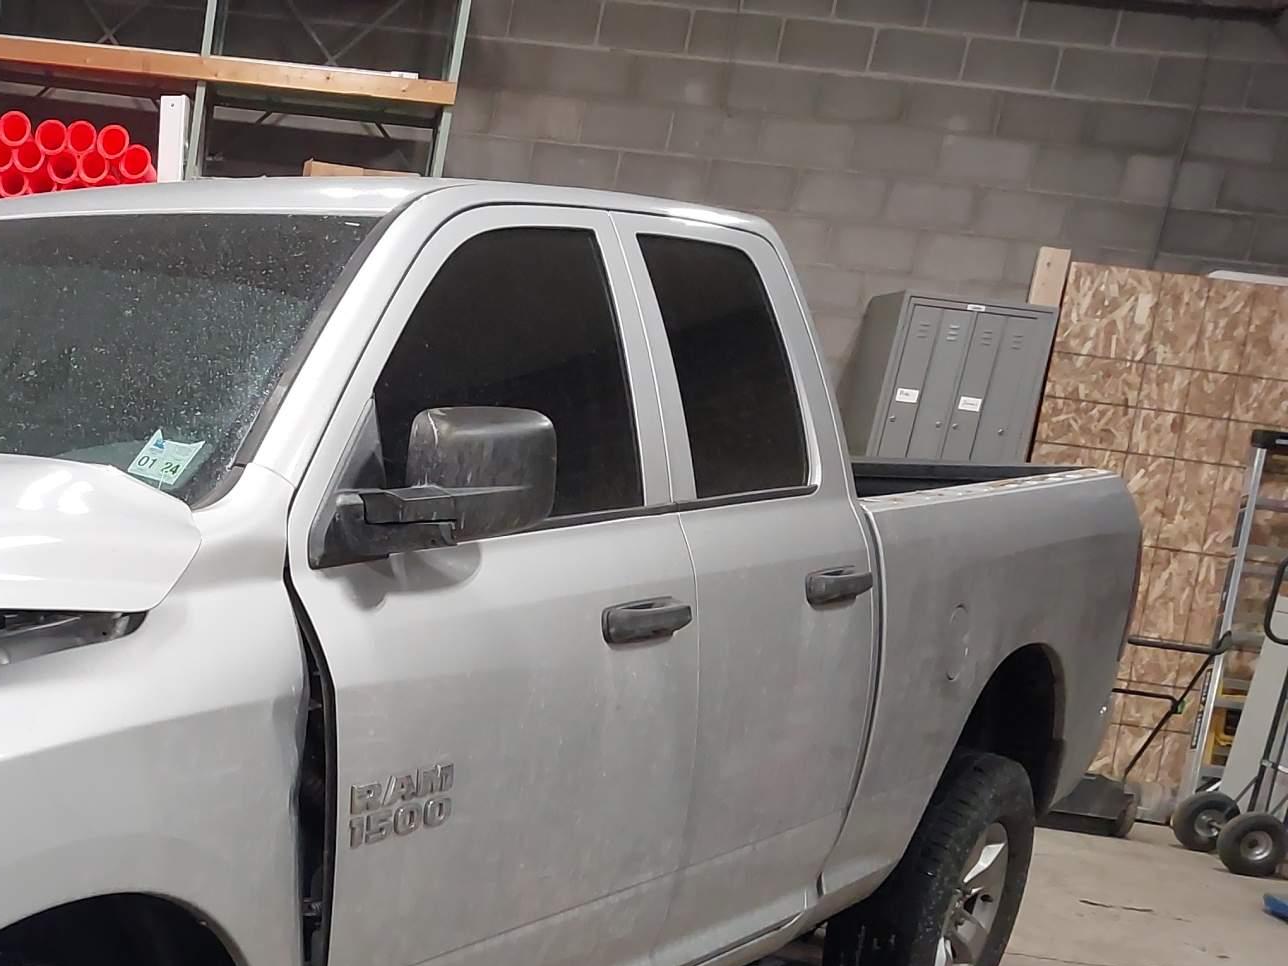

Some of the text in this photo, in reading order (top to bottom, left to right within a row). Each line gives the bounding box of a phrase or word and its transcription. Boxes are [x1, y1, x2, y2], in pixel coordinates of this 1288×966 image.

[138, 455, 180, 475] 01 24
[349, 763, 455, 816] RAM
[349, 796, 454, 849] 1500
